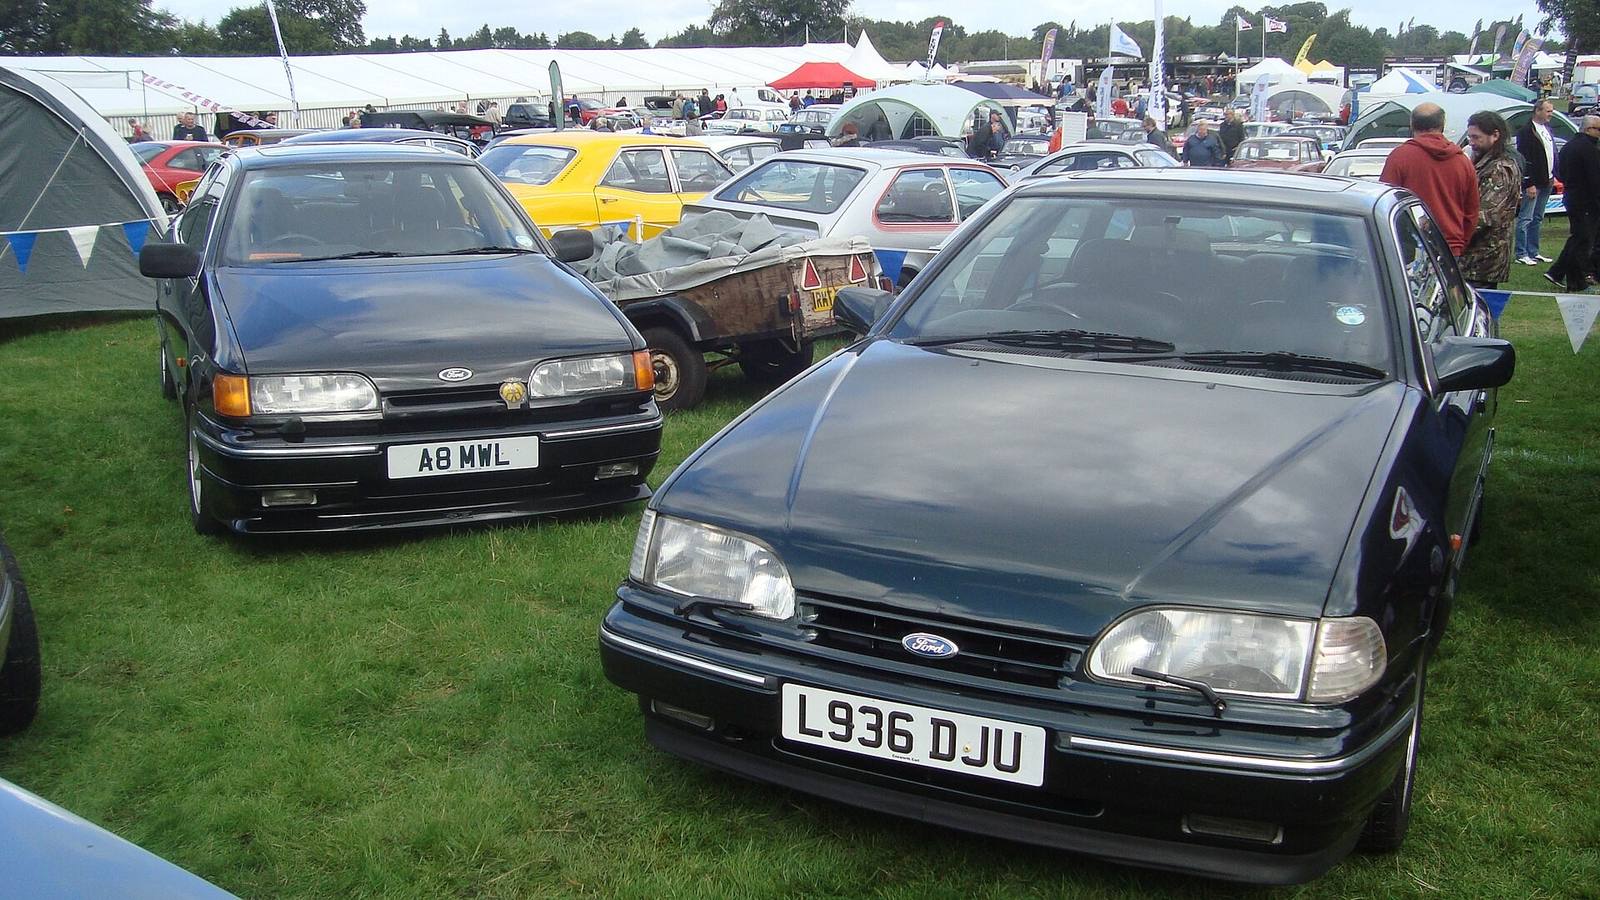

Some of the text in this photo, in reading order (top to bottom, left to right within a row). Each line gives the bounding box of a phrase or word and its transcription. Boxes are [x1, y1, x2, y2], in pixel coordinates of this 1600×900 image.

[418, 443, 509, 472] A8 MWL
[911, 636, 945, 654] Ford
[798, 694, 1022, 773] L936 DJU
